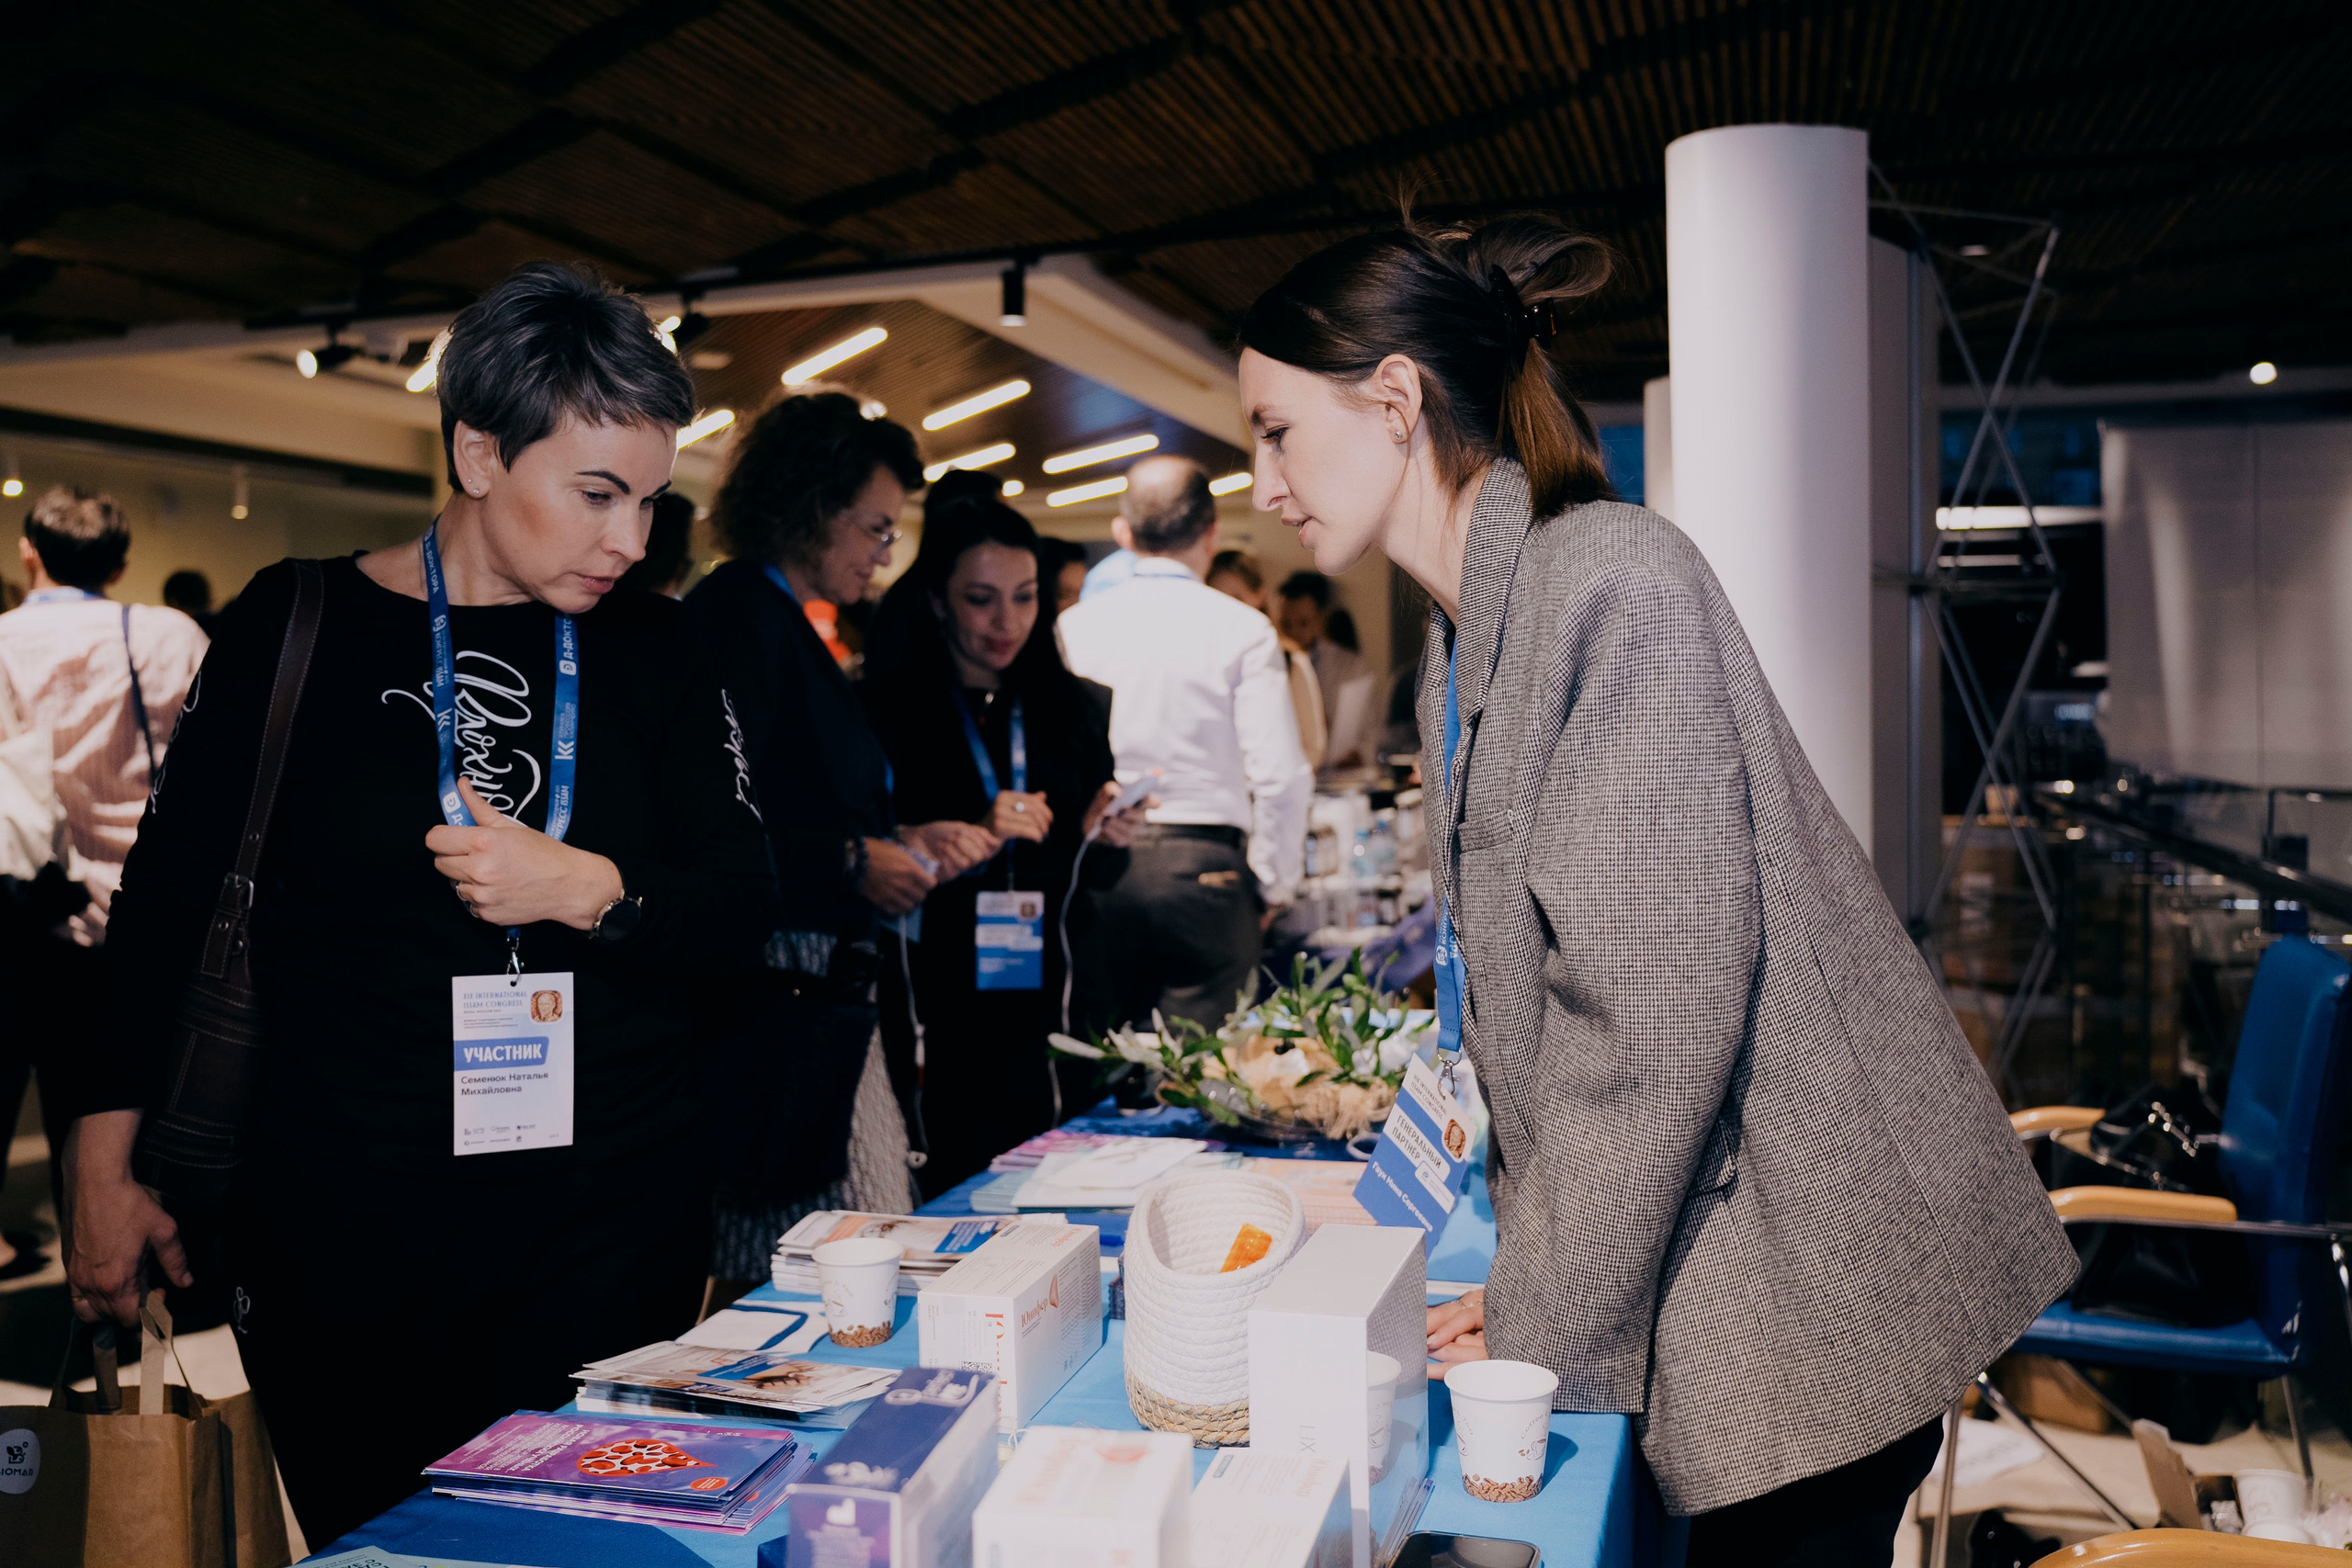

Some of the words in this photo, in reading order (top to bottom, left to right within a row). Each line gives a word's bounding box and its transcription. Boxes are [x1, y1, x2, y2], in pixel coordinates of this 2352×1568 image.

[486, 999, 523, 1008] CONGRESS
[463, 1043, 542, 1063] УЧАСТНИК
[461, 1075, 507, 1084] Семенюк
[509, 1072, 548, 1081] Наталья
[461, 1086, 522, 1096] Михайловна
[1422, 1092, 1443, 1120] CONGRESS
[1392, 1125, 1420, 1160] ПАРТНЁР
[1396, 1114, 1442, 1169] ГЕНЕРАЛЬНЫЙ
[1372, 1161, 1387, 1181] Гаук
[1386, 1176, 1403, 1198] Нина
[1401, 1193, 1433, 1233] Сергеевна
[0, 1468, 34, 1476] IOMAR
